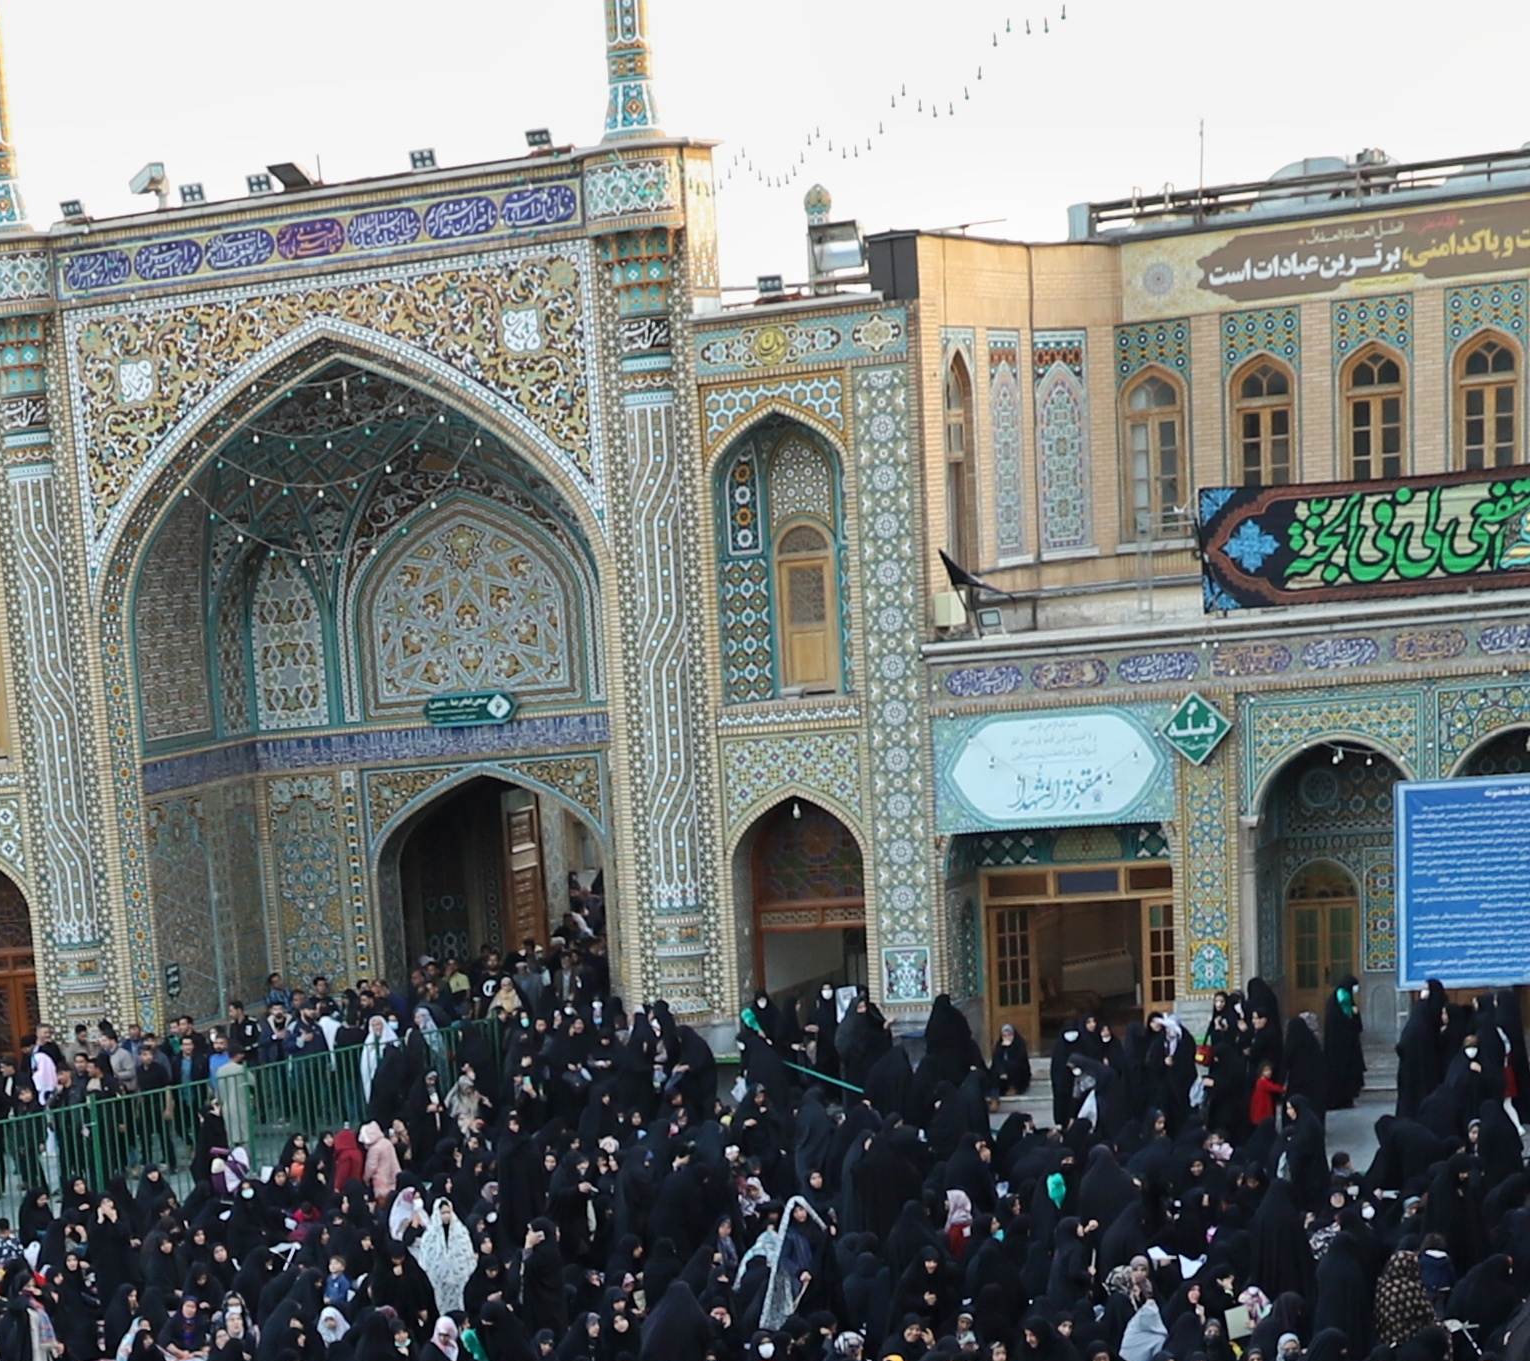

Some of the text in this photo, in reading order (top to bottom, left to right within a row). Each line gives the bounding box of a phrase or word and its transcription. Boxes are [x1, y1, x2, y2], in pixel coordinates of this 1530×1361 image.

[1208, 256, 1252, 287] است
[1253, 252, 1319, 281] عبادات
[1320, 241, 1402, 280] برترین
[1168, 712, 1218, 741] قبله
